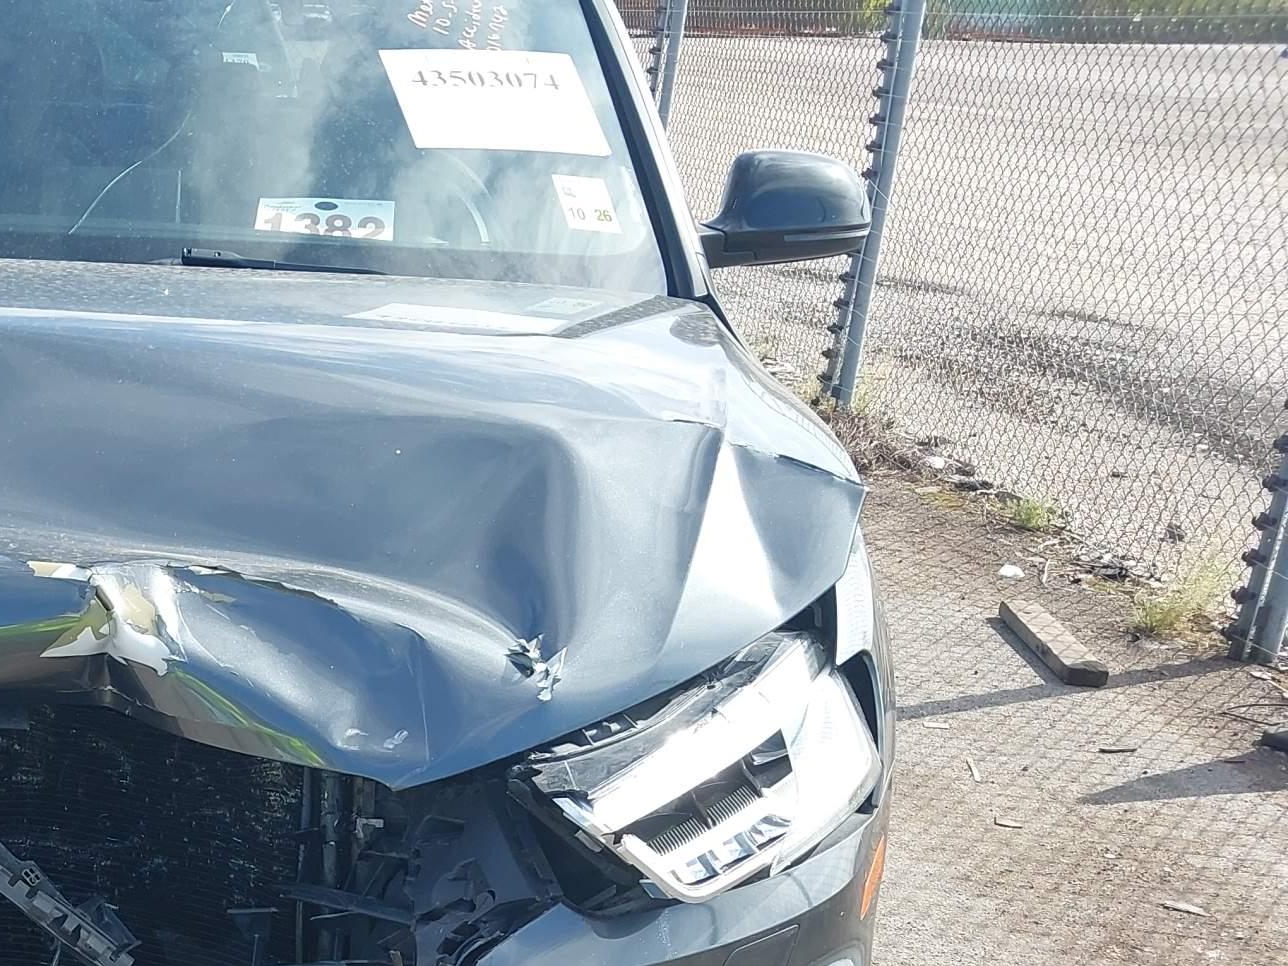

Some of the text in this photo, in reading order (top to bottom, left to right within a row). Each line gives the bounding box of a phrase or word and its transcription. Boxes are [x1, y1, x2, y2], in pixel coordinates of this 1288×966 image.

[411, 69, 561, 91] 43503074
[263, 212, 386, 239] 1382
[568, 207, 613, 222] 10 26
